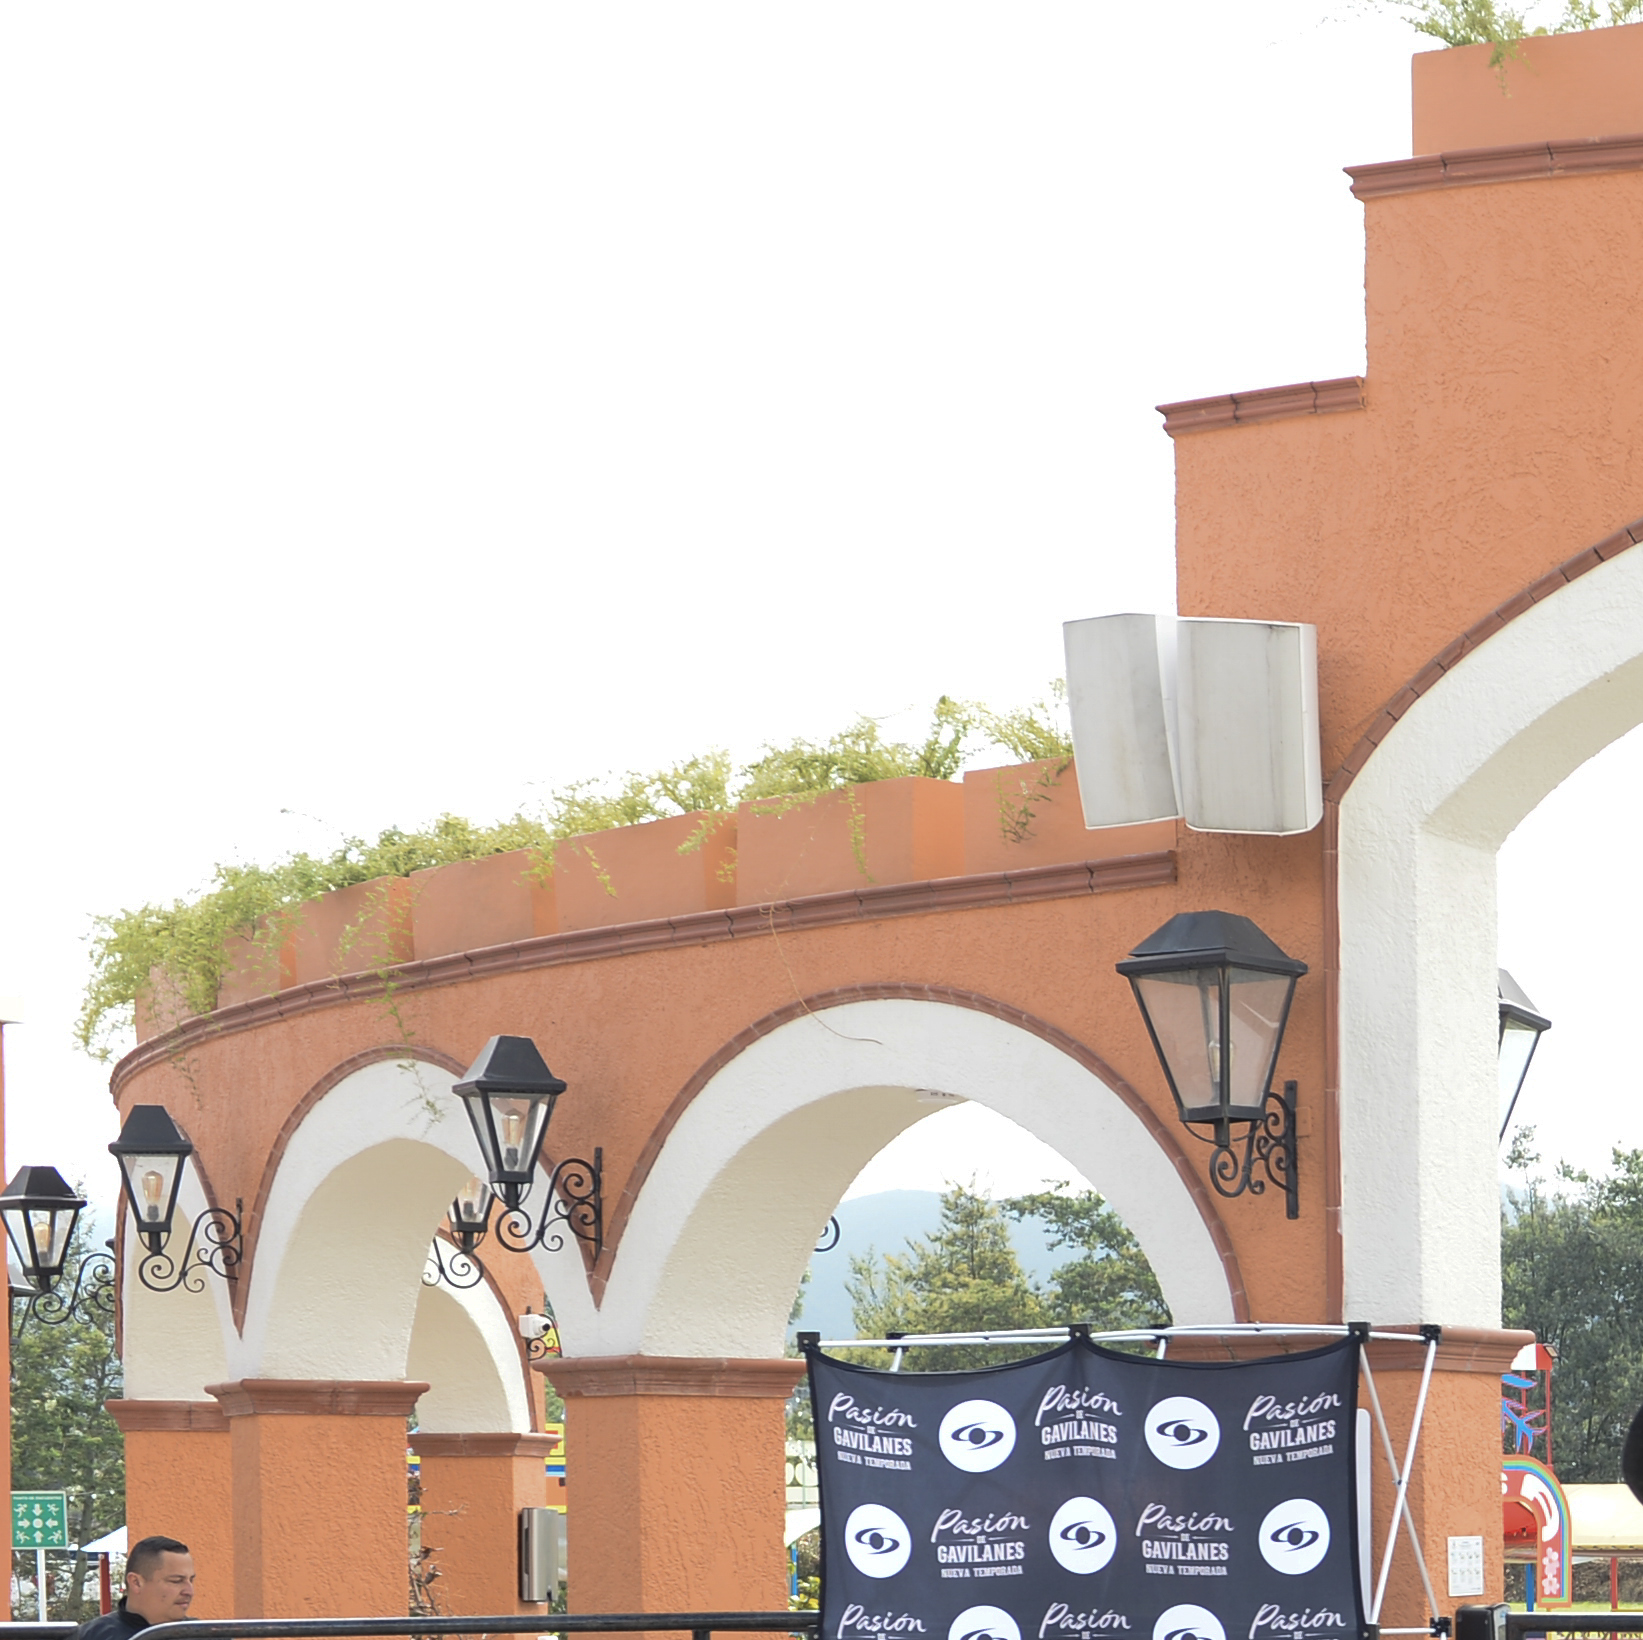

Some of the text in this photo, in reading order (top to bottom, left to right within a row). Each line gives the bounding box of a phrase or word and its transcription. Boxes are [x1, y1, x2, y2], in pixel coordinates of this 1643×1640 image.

[828, 1392, 918, 1428] Pasión
[1034, 1384, 1123, 1427] Pasión
[1242, 1392, 1342, 1431] Pasión
[833, 1426, 913, 1456] GAVILANES
[1041, 1420, 1118, 1446] GAVILANES
[1249, 1419, 1336, 1451] GAVILANES
[930, 1508, 1030, 1544] Pasión
[1135, 1502, 1234, 1537] Pasión
[937, 1541, 1025, 1564] GAVILANES
[1142, 1539, 1229, 1561] GAVILANES
[836, 1603, 927, 1640] Pasión
[1038, 1602, 1132, 1639] Pasión
[1248, 1603, 1346, 1640] Pasión
